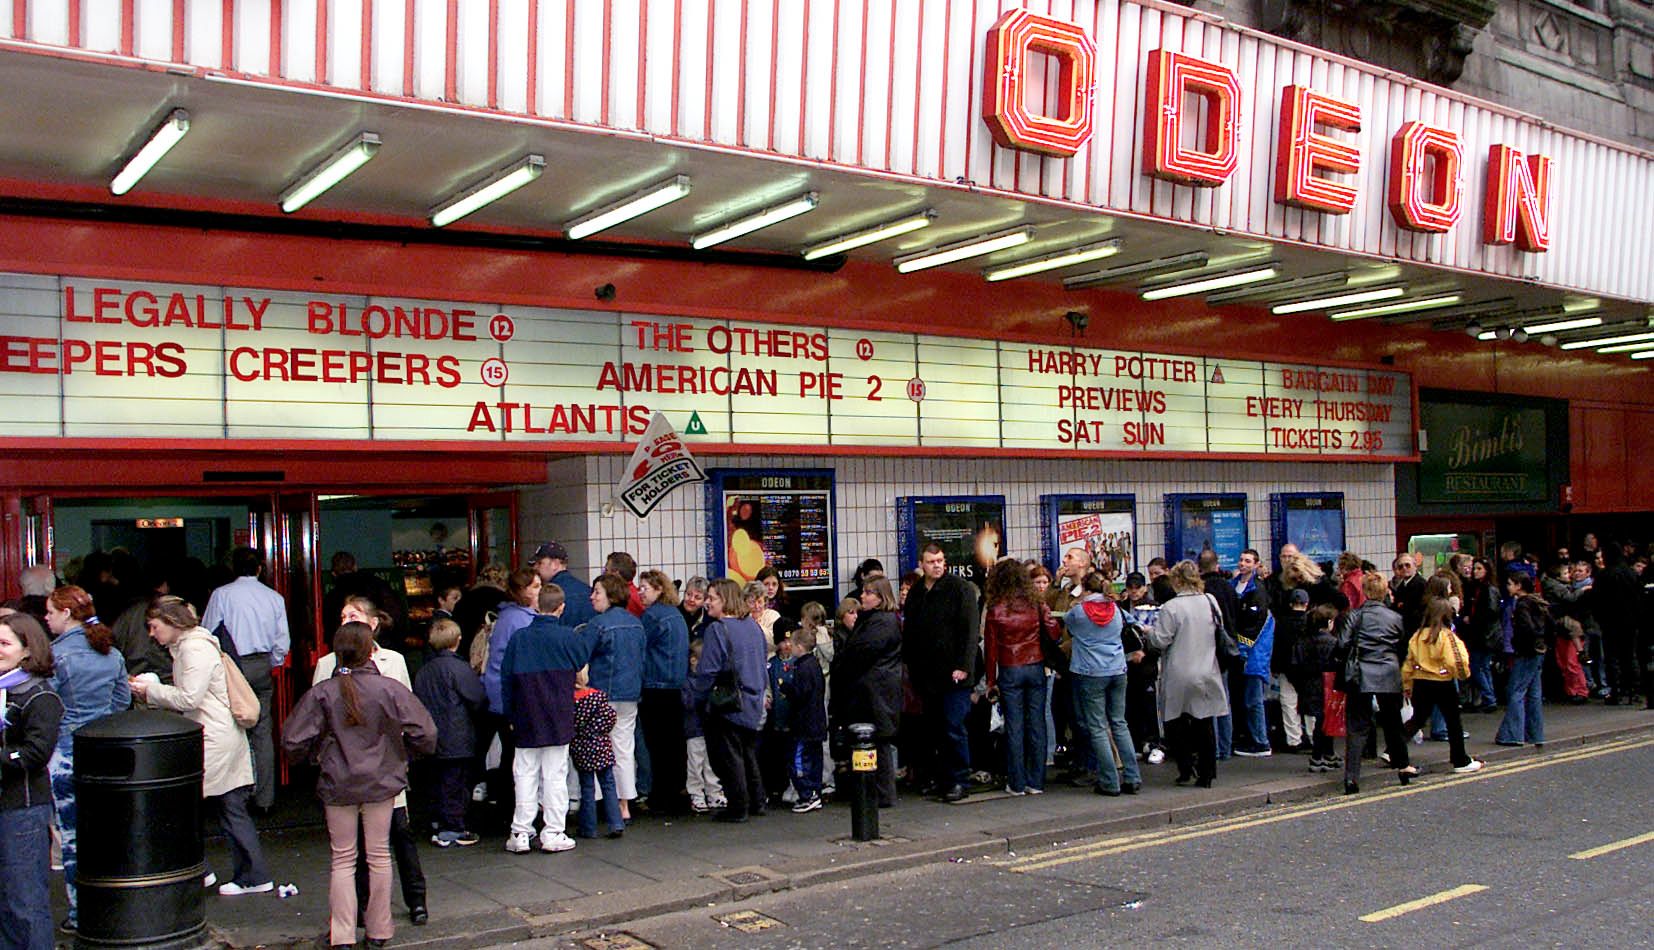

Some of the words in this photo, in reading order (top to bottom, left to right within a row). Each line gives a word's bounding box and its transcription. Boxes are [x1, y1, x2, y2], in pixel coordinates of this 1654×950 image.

[983, 8, 1554, 253] ODEON
[65, 286, 271, 330] LEGALLY
[307, 301, 477, 341] BLONDE
[631, 320, 694, 353] THE
[707, 325, 830, 361] OTHERS
[0, 336, 188, 377] EEPERS
[230, 347, 461, 388] CREEPERS
[1028, 349, 1102, 376] HARRY
[1114, 356, 1196, 383] POTTER
[597, 362, 777, 397] AMERICAN
[801, 371, 843, 400] PIE
[866, 375, 882, 401] 2
[1282, 369, 1359, 393] BARGAIN
[1368, 375, 1396, 396] DAY
[1058, 385, 1166, 414] PREVIEWS
[1246, 396, 1303, 418] EVERY
[1314, 400, 1392, 422] THURSDAY
[467, 402, 650, 435] ATLANTIS
[691, 420, 700, 431] U
[1057, 419, 1104, 444] SAT
[1123, 422, 1165, 445] SUN
[1271, 427, 1342, 449] TICKETS
[1351, 430, 1383, 450] 2.95
[628, 482, 651, 501] FOR
[651, 462, 690, 484] TICKET
[641, 471, 690, 505] HOLDERS
[761, 477, 792, 488] ODEON
[1445, 475, 1529, 490] RESTAURANT
[945, 503, 971, 512] ODEON
